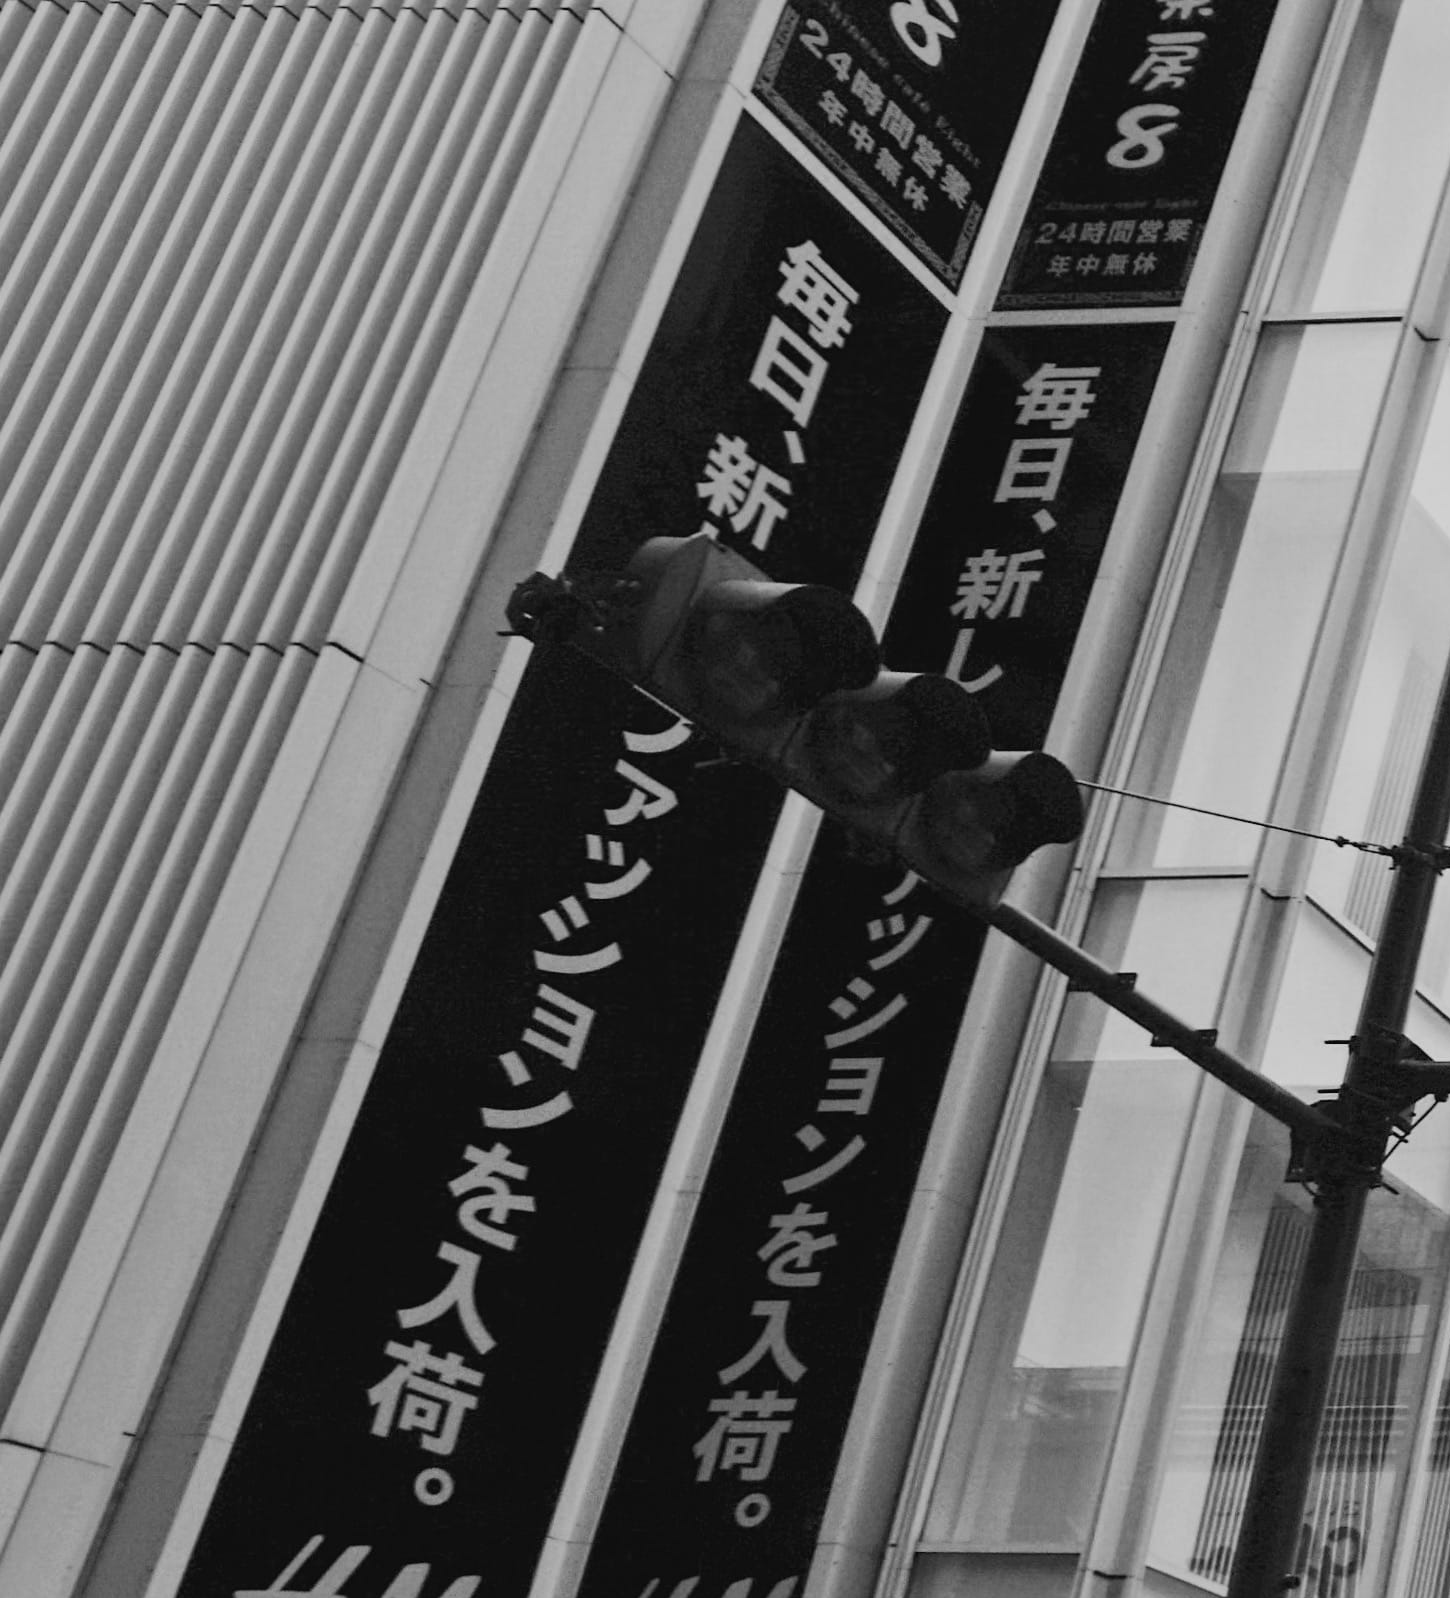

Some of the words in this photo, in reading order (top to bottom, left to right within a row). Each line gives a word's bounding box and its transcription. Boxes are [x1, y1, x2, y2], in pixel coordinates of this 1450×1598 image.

[799, 18, 972, 208] 24時間営業
[816, 89, 930, 211] 年中無休
[1034, 218, 1194, 246] 24時間営業
[1046, 252, 1158, 278] 年中無休
